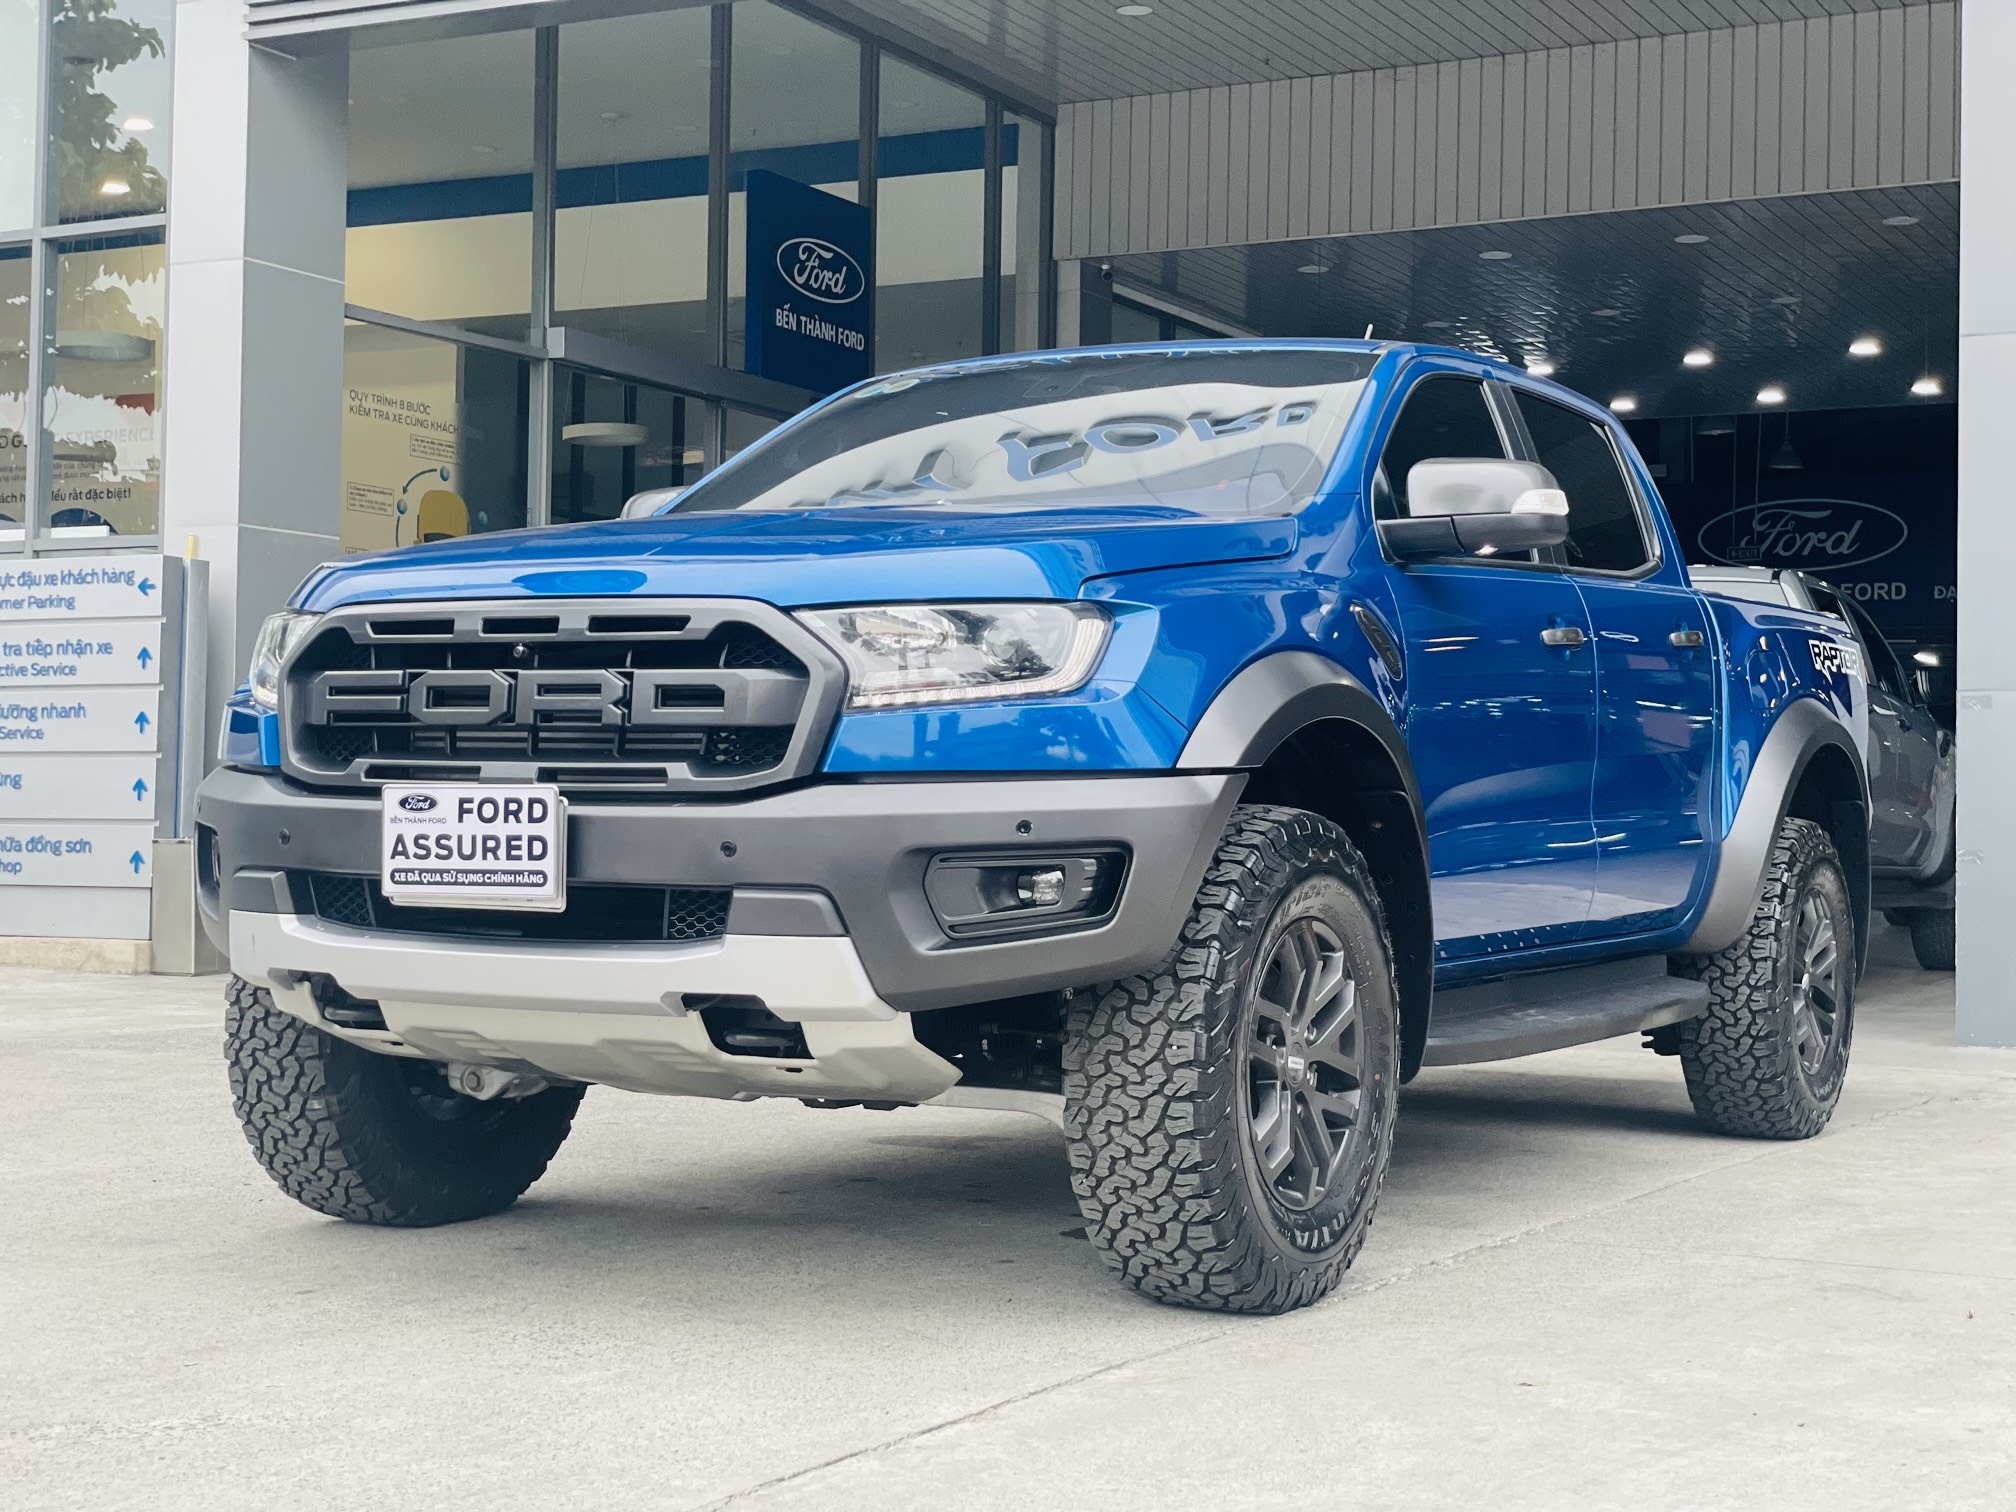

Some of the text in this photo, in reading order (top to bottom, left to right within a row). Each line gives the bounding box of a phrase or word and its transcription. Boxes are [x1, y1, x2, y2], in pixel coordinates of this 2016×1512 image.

[794, 242, 847, 294] Ford
[776, 303, 864, 351] BẾN THÀNH FORD
[371, 393, 398, 409] TRÌNH
[406, 400, 431, 416] BƯỚC
[373, 409, 391, 421] TRA
[391, 413, 404, 424] XE
[84, 487, 104, 503] đặc
[106, 487, 132, 501] biệt!
[1738, 507, 1863, 557] Ford
[43, 573, 59, 586] xe
[60, 569, 100, 586] khách
[101, 567, 136, 586] hàng
[1840, 581, 1908, 601] FORD
[27, 594, 77, 611] Parking
[3, 641, 23, 657] tra
[56, 638, 93, 660] nhận
[95, 641, 114, 655] xe
[30, 661, 78, 677] Service
[306, 668, 750, 727] FORD
[41, 702, 87, 719] nhanh
[0, 726, 45, 740] Service
[405, 796, 549, 824] Ford FORD
[404, 816, 427, 824] THÀNH
[428, 817, 447, 825] FORD
[65, 838, 93, 855] sơn
[389, 833, 549, 861] ASSURED
[393, 871, 407, 882] XE
[407, 870, 421, 882] ĐÃ
[421, 872, 441, 884] QUA
[484, 871, 515, 883] CHÍNH
[516, 871, 544, 884] HÃNG
